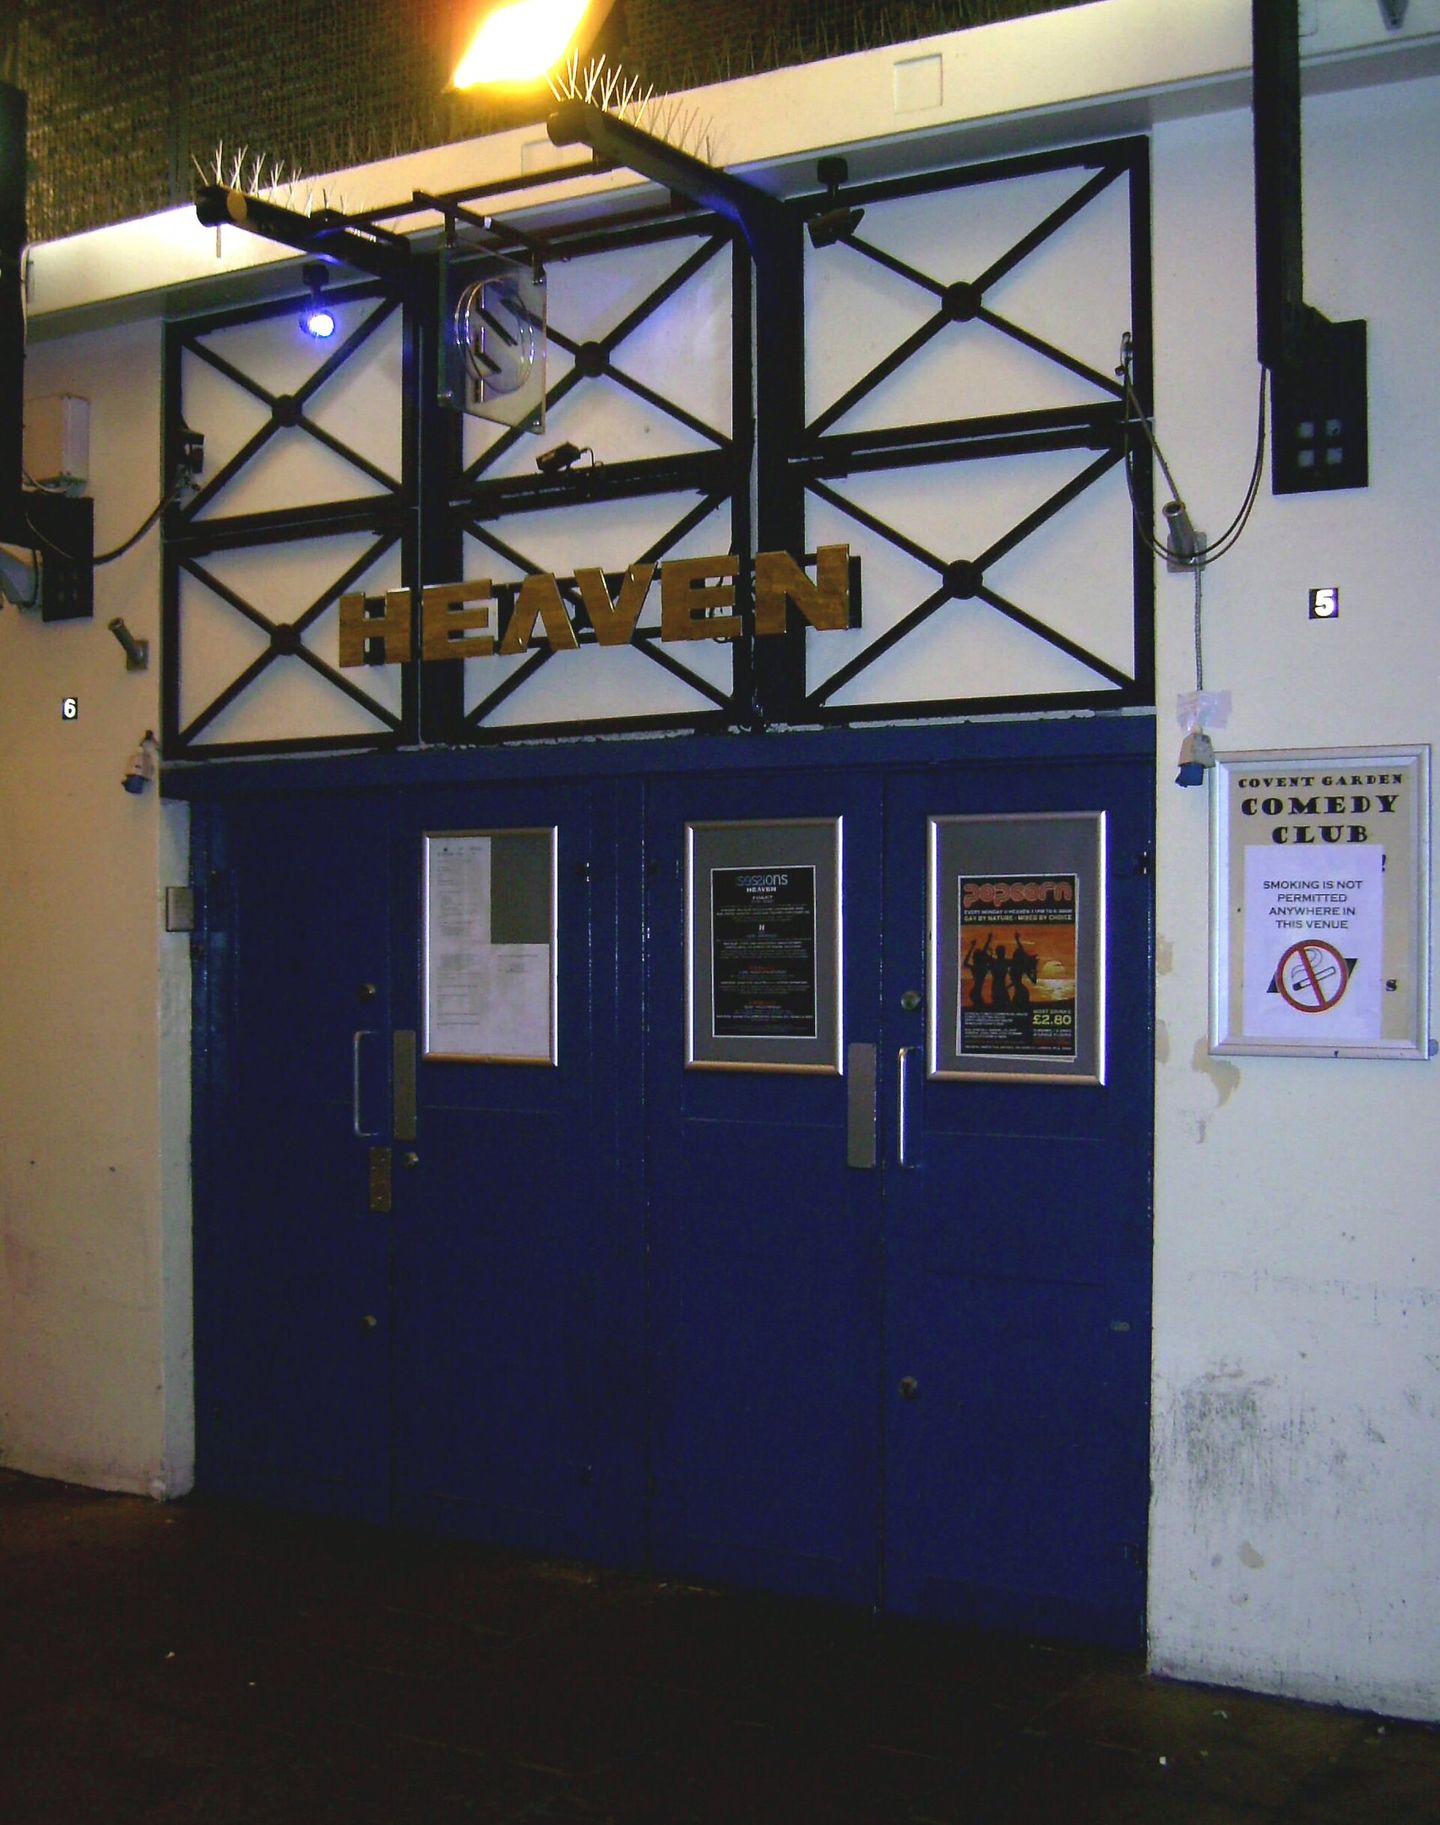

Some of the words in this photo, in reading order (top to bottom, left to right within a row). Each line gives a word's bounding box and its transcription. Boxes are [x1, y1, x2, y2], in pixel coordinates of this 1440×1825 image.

[339, 544, 850, 668] HEAVEN
[1314, 589, 1335, 617] 5
[63, 698, 77, 718] 6
[1238, 776, 1315, 788] COVENT
[1321, 773, 1403, 786] GARDEN
[1241, 794, 1400, 816] COMEDY
[1271, 824, 1367, 844] CLUB
[1263, 880, 1320, 890] SMOKING
[1322, 880, 1334, 889] IS
[1337, 880, 1363, 889] NOT
[1277, 893, 1348, 902] PERMITTED
[1268, 906, 1340, 916] ANYWHERE
[1343, 906, 1356, 915] IN
[1275, 919, 1303, 929] THIS
[1305, 919, 1349, 929] VENUE
[1032, 1014, 1072, 1025] £2.80
